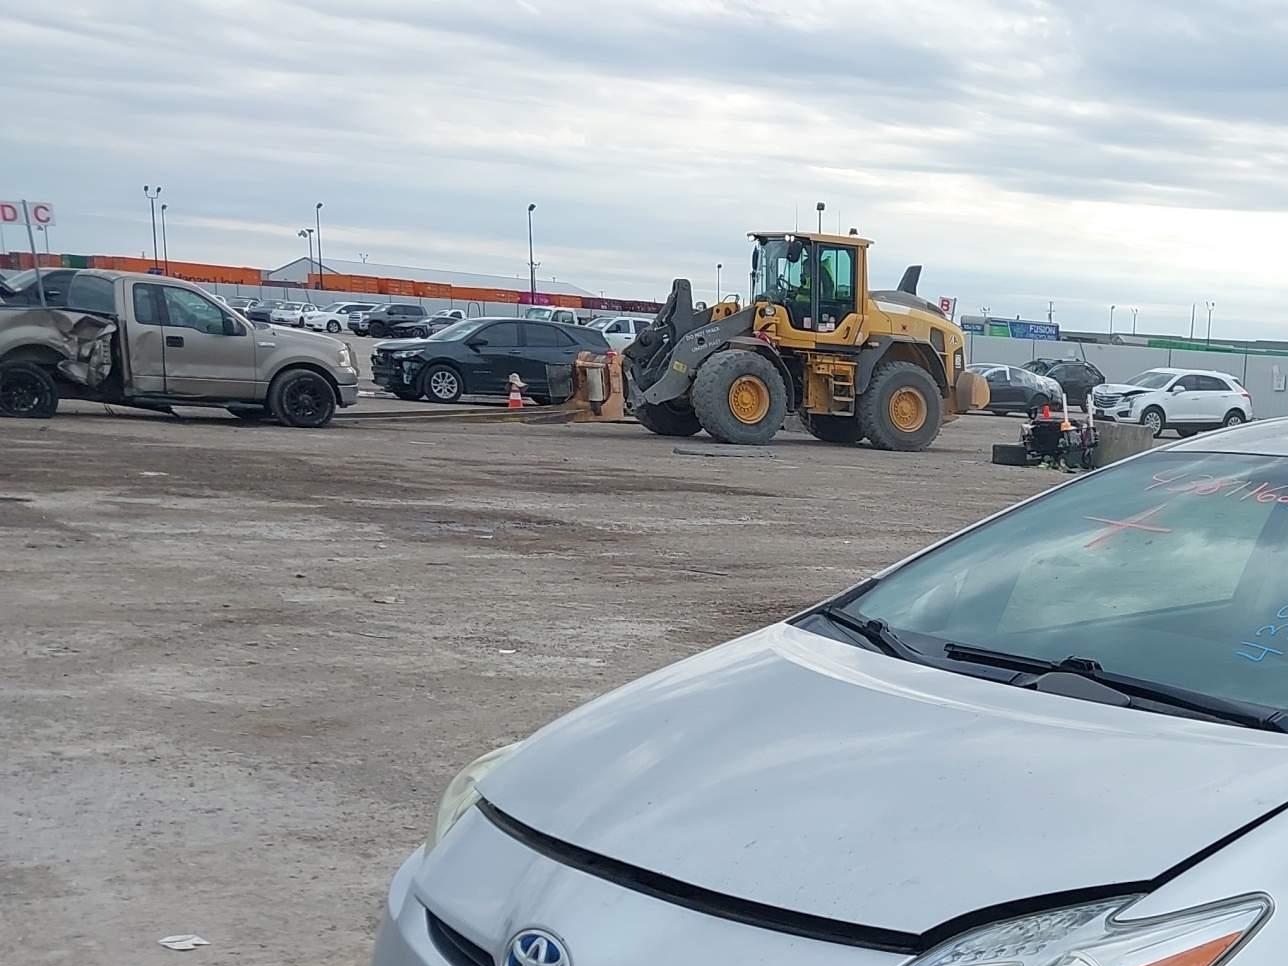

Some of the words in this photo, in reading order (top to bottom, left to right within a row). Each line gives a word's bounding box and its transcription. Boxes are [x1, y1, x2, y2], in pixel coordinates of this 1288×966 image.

[0, 204, 17, 222] D
[34, 205, 50, 223] C
[940, 299, 950, 311] B
[1029, 324, 1056, 335] FUSION
